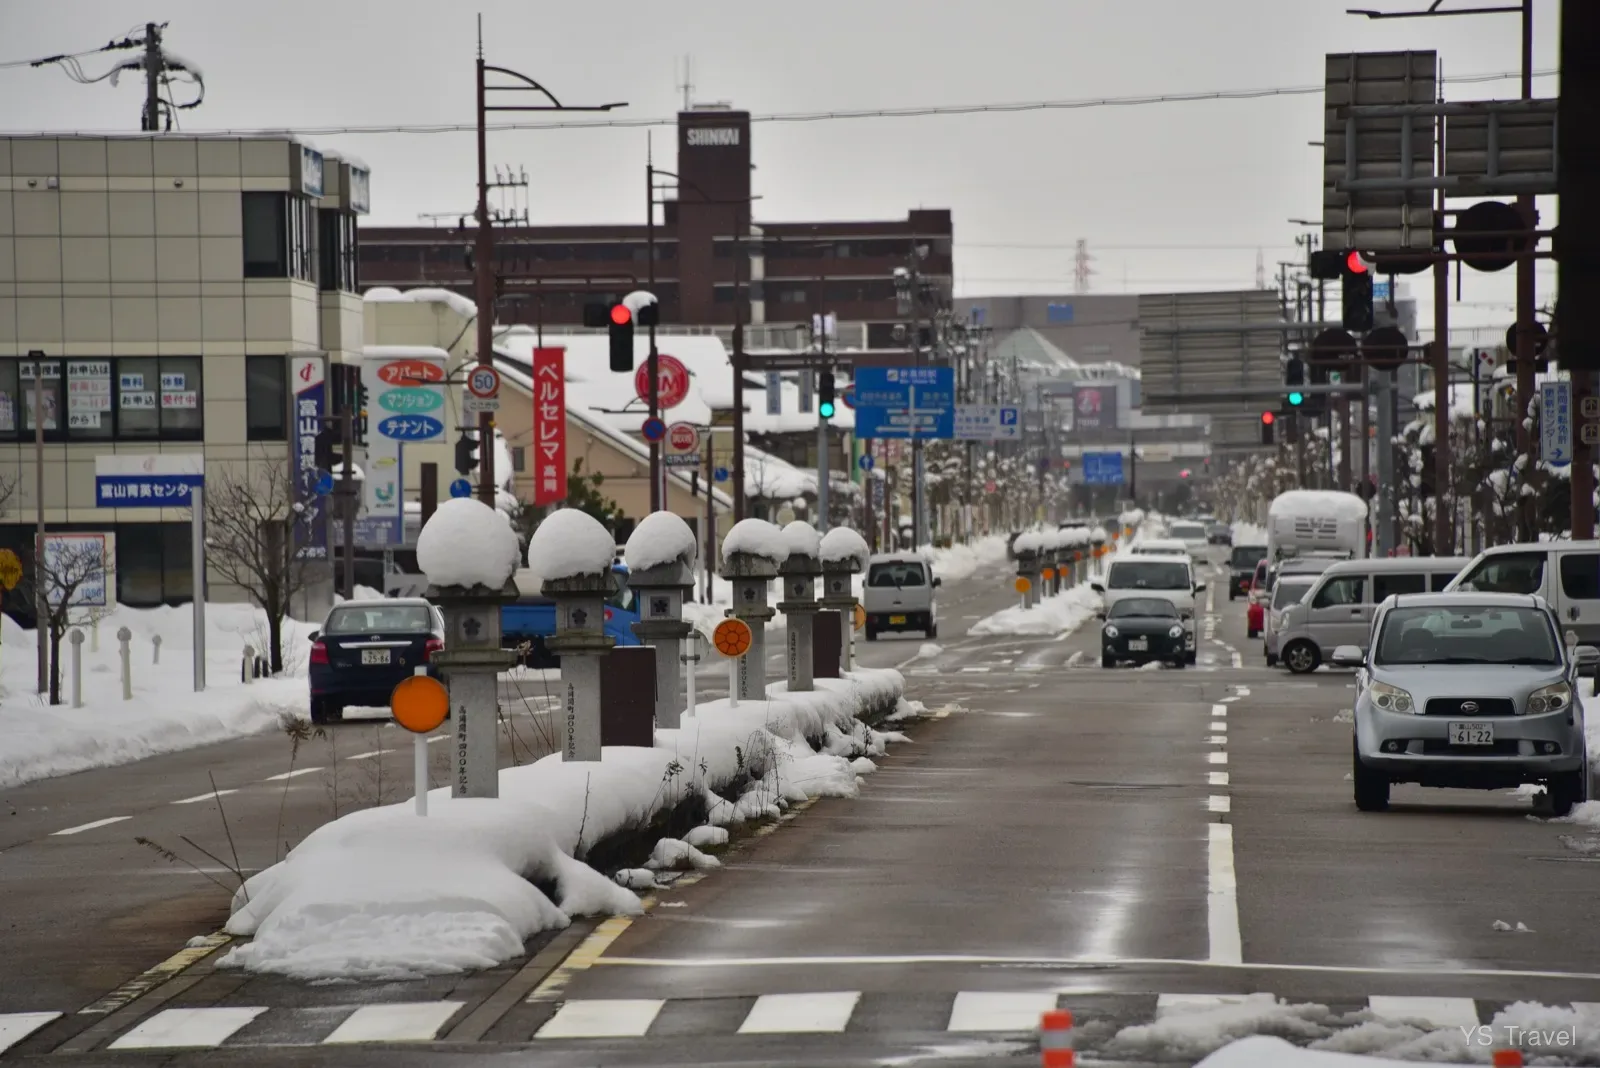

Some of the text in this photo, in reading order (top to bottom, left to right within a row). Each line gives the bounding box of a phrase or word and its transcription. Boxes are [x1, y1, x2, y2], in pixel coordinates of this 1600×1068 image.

[687, 128, 739, 145] SHINKAI
[387, 366, 434, 380] アパート
[474, 375, 493, 390] 50
[387, 394, 434, 408] マンション
[538, 363, 559, 460] ベルセレマ
[386, 421, 434, 435] テナント
[101, 483, 192, 499] 富山育英センタ
[1458, 731, 1491, 743] 61-22
